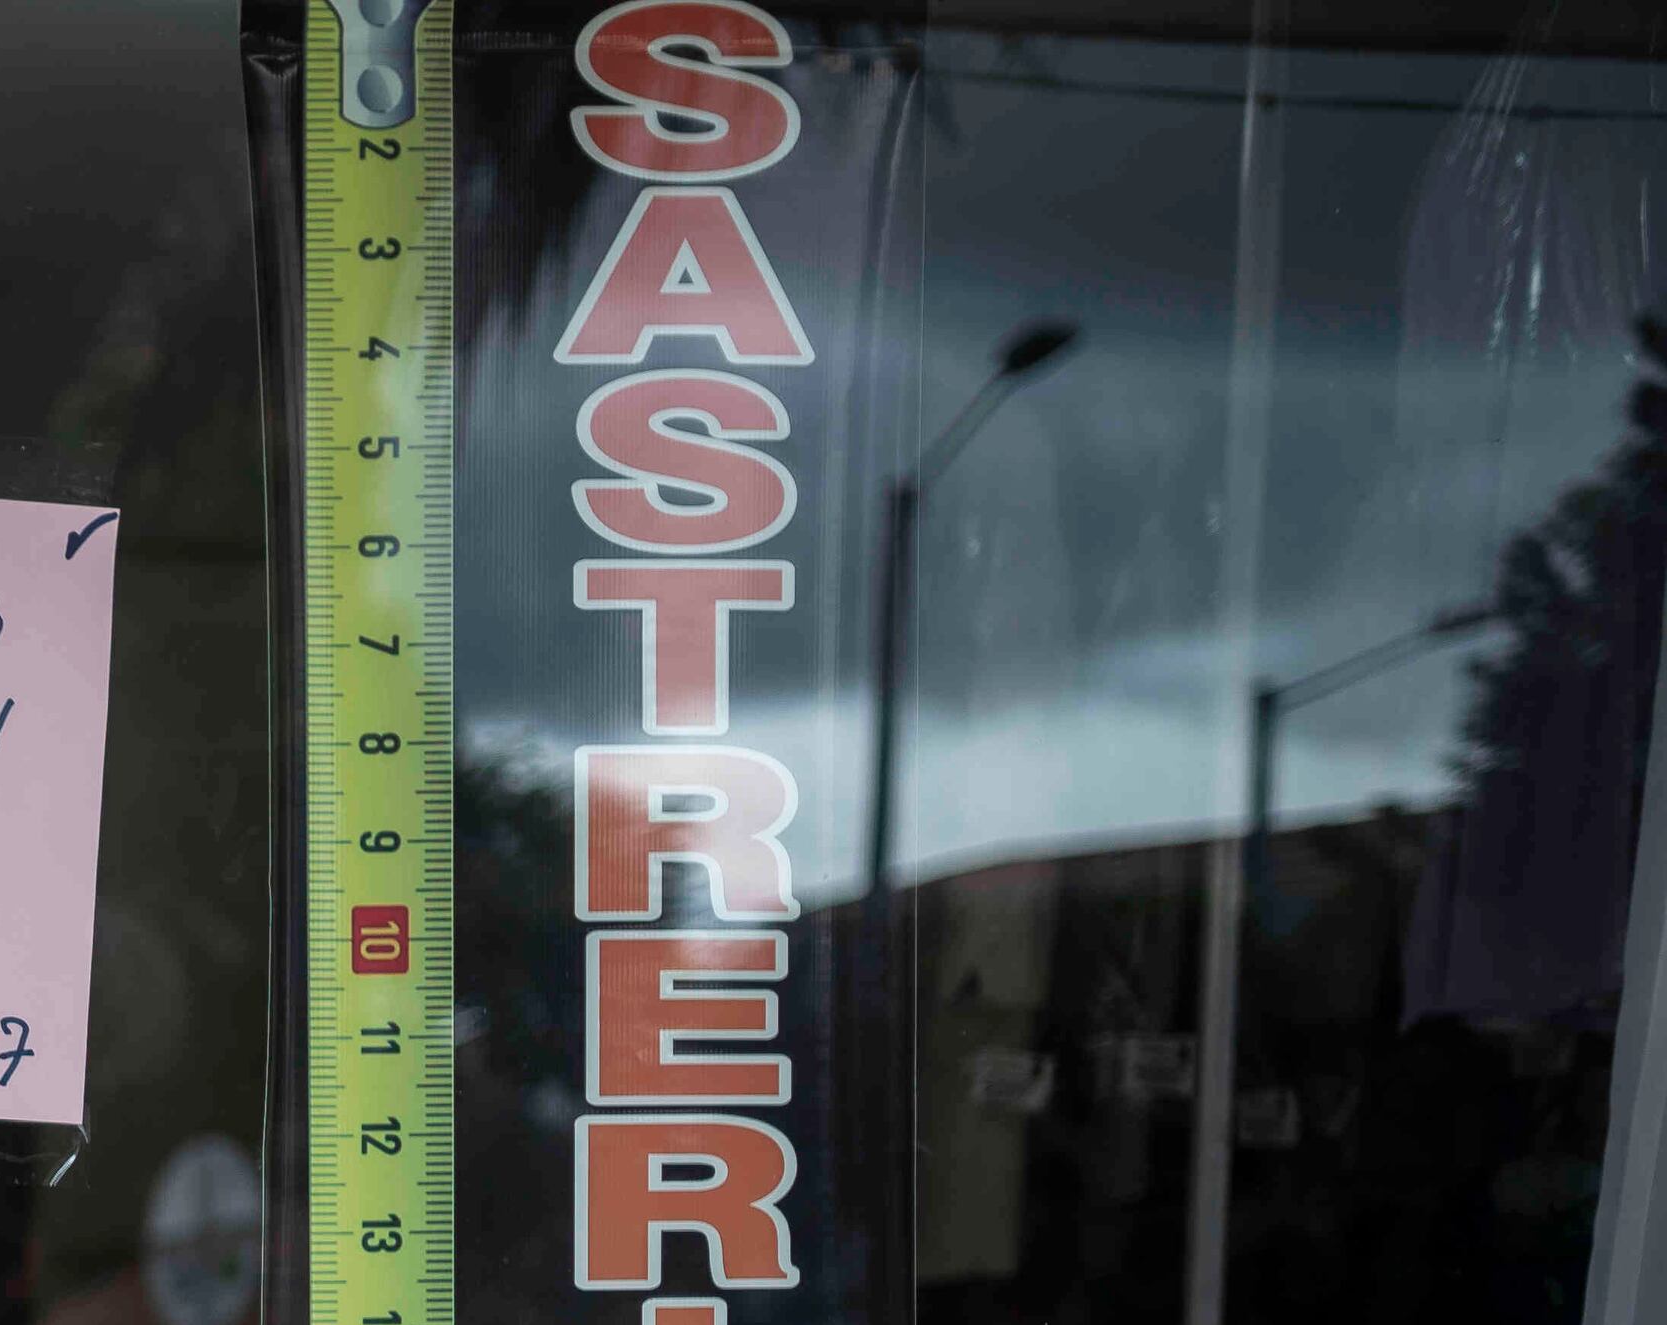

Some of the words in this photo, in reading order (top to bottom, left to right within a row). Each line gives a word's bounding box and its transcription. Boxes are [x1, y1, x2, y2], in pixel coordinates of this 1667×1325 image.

[359, 138, 401, 161] 2
[359, 237, 401, 260] 3
[359, 337, 399, 360] 4
[358, 437, 398, 459] 5
[359, 536, 399, 557] 6
[359, 635, 399, 655] 7
[359, 733, 401, 754] 8
[360, 831, 400, 852] 9
[361, 922, 399, 959] 10
[361, 1022, 400, 1053] 11
[362, 1117, 401, 1155] 12
[362, 1214, 402, 1252] 13
